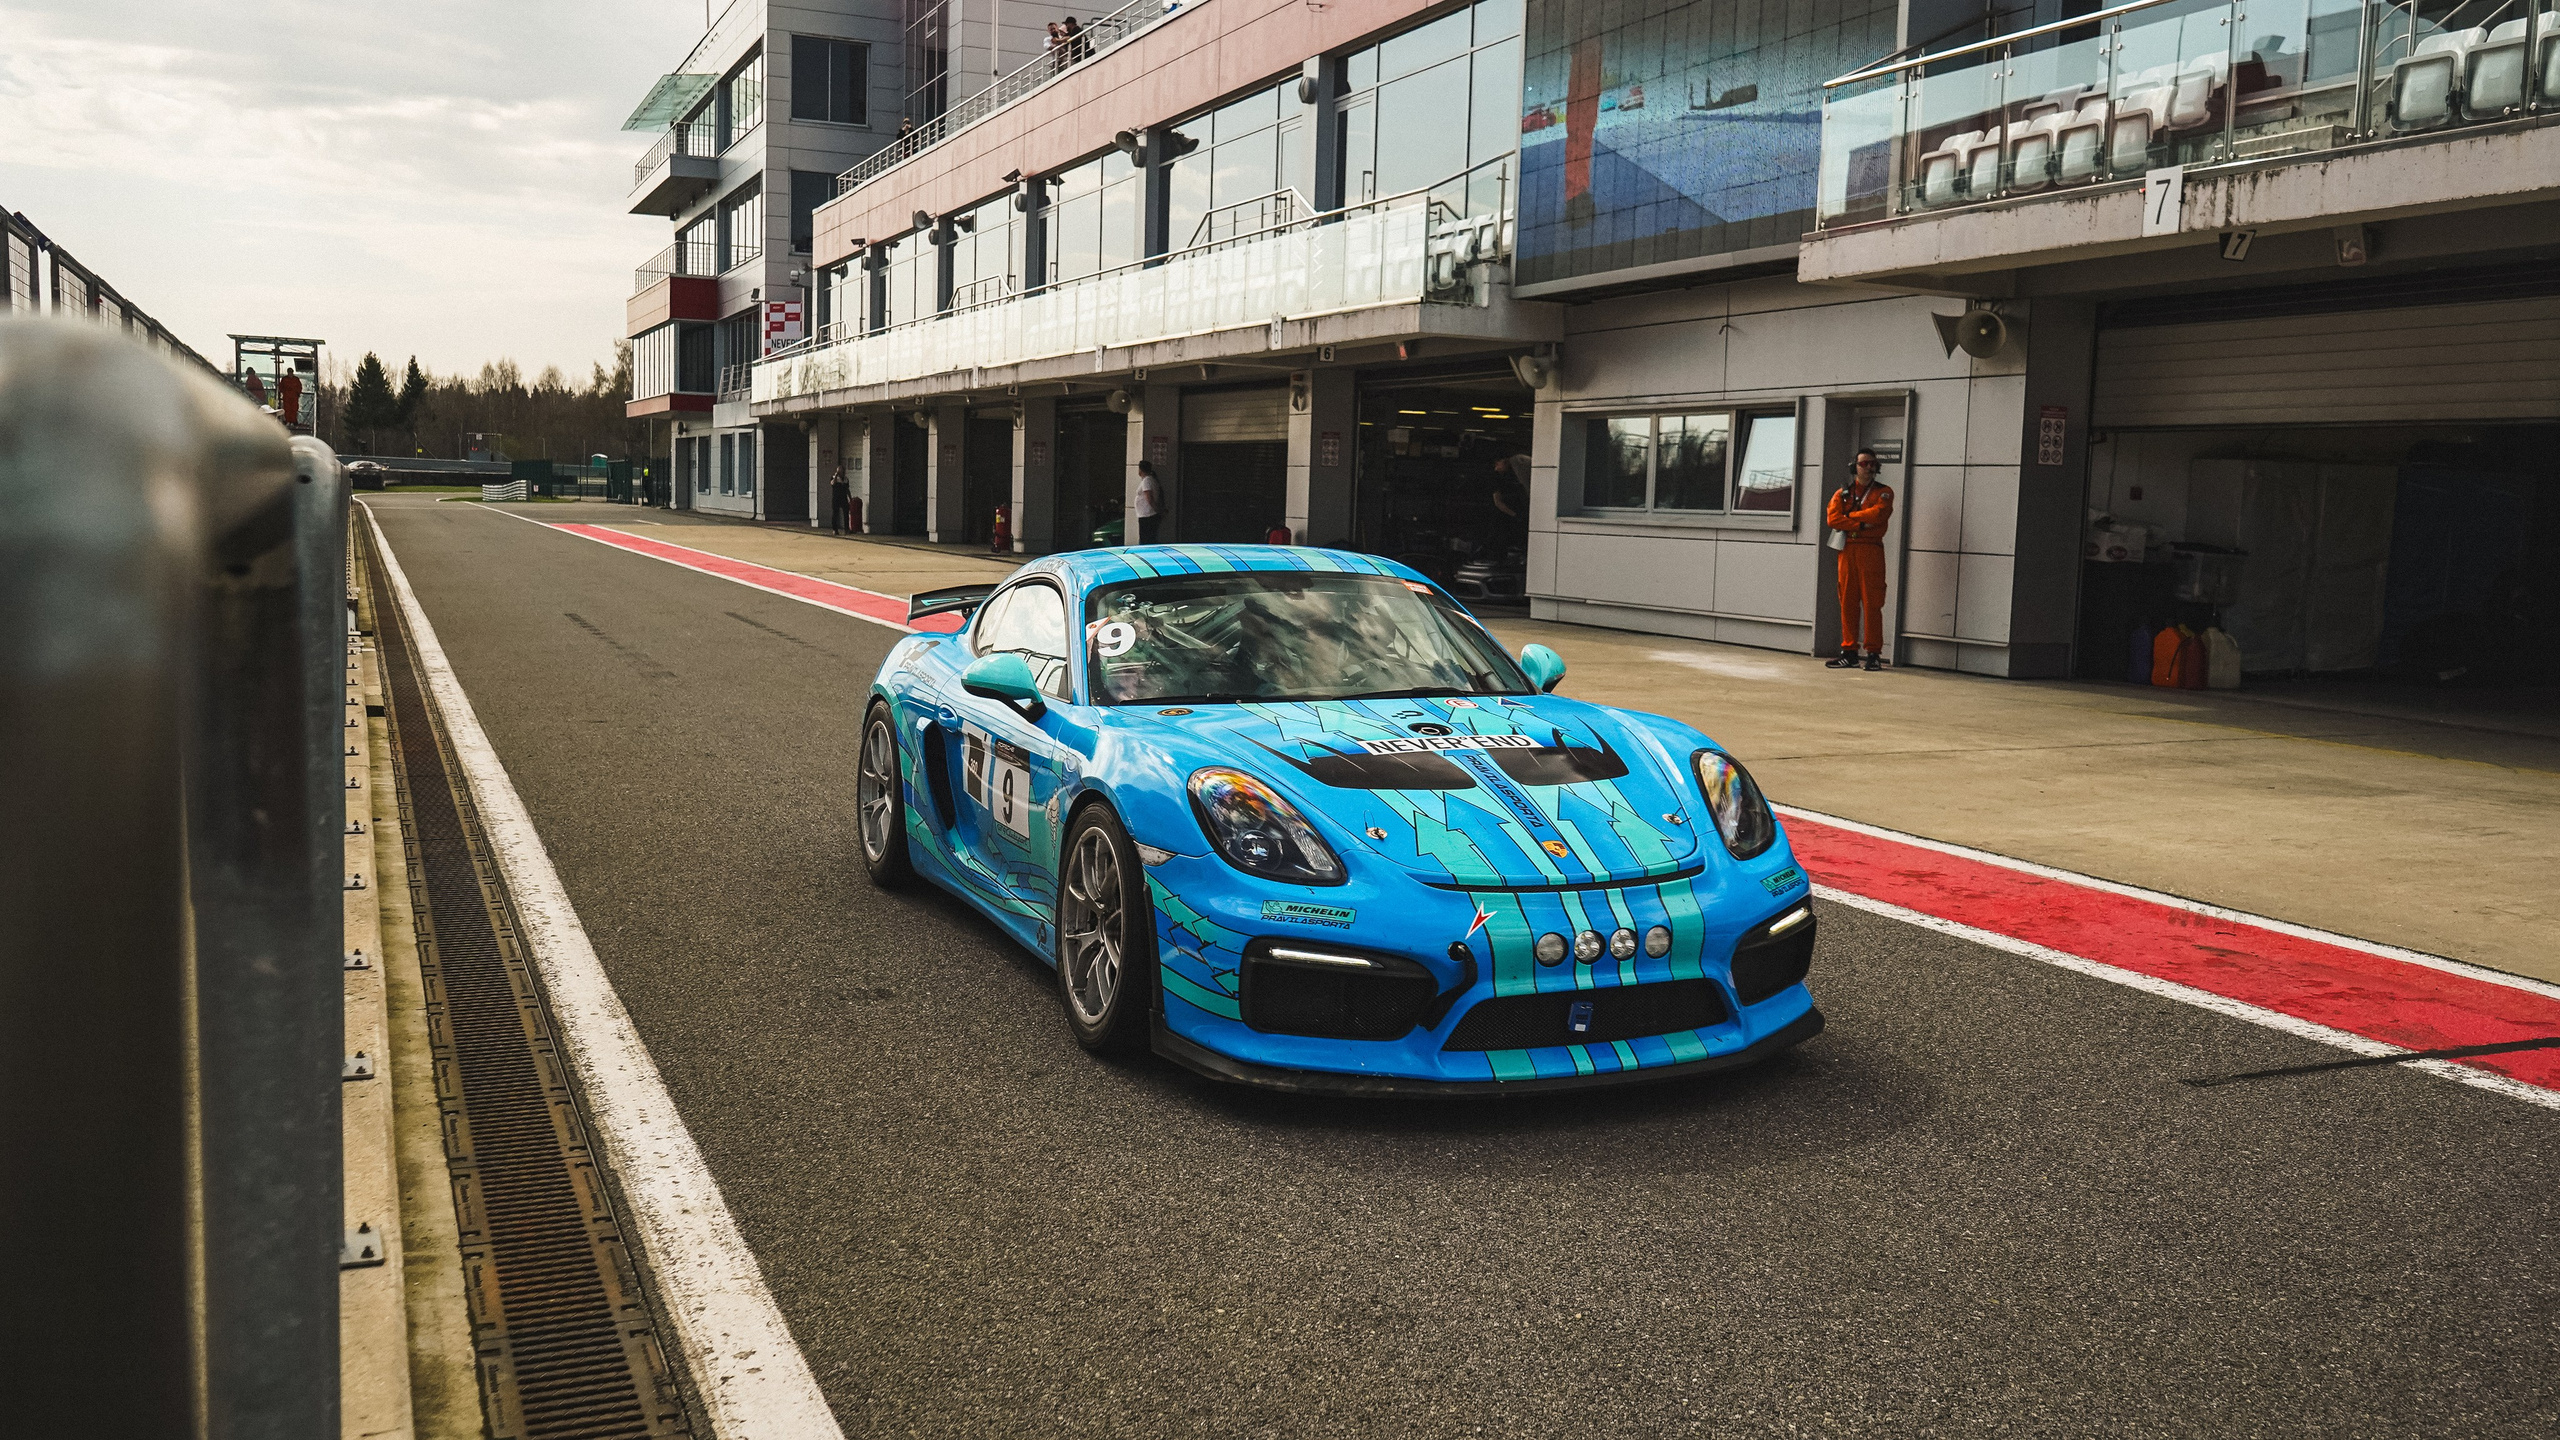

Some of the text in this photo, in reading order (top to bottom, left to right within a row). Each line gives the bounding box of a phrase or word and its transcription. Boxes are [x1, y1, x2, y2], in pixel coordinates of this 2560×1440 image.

[2155, 178, 2172, 225] 7
[2231, 232, 2248, 256] 7
[1323, 346, 1331, 360] 6
[1137, 368, 1144, 379] 5
[1096, 621, 1137, 657] 9
[1002, 768, 1015, 825] 9
[1461, 753, 1546, 828] PRAVILASPORTA
[1771, 869, 1797, 884] MICHELIN
[1284, 904, 1351, 918] MICHELIN
[1260, 914, 1351, 930] PRAVILASPORTA
